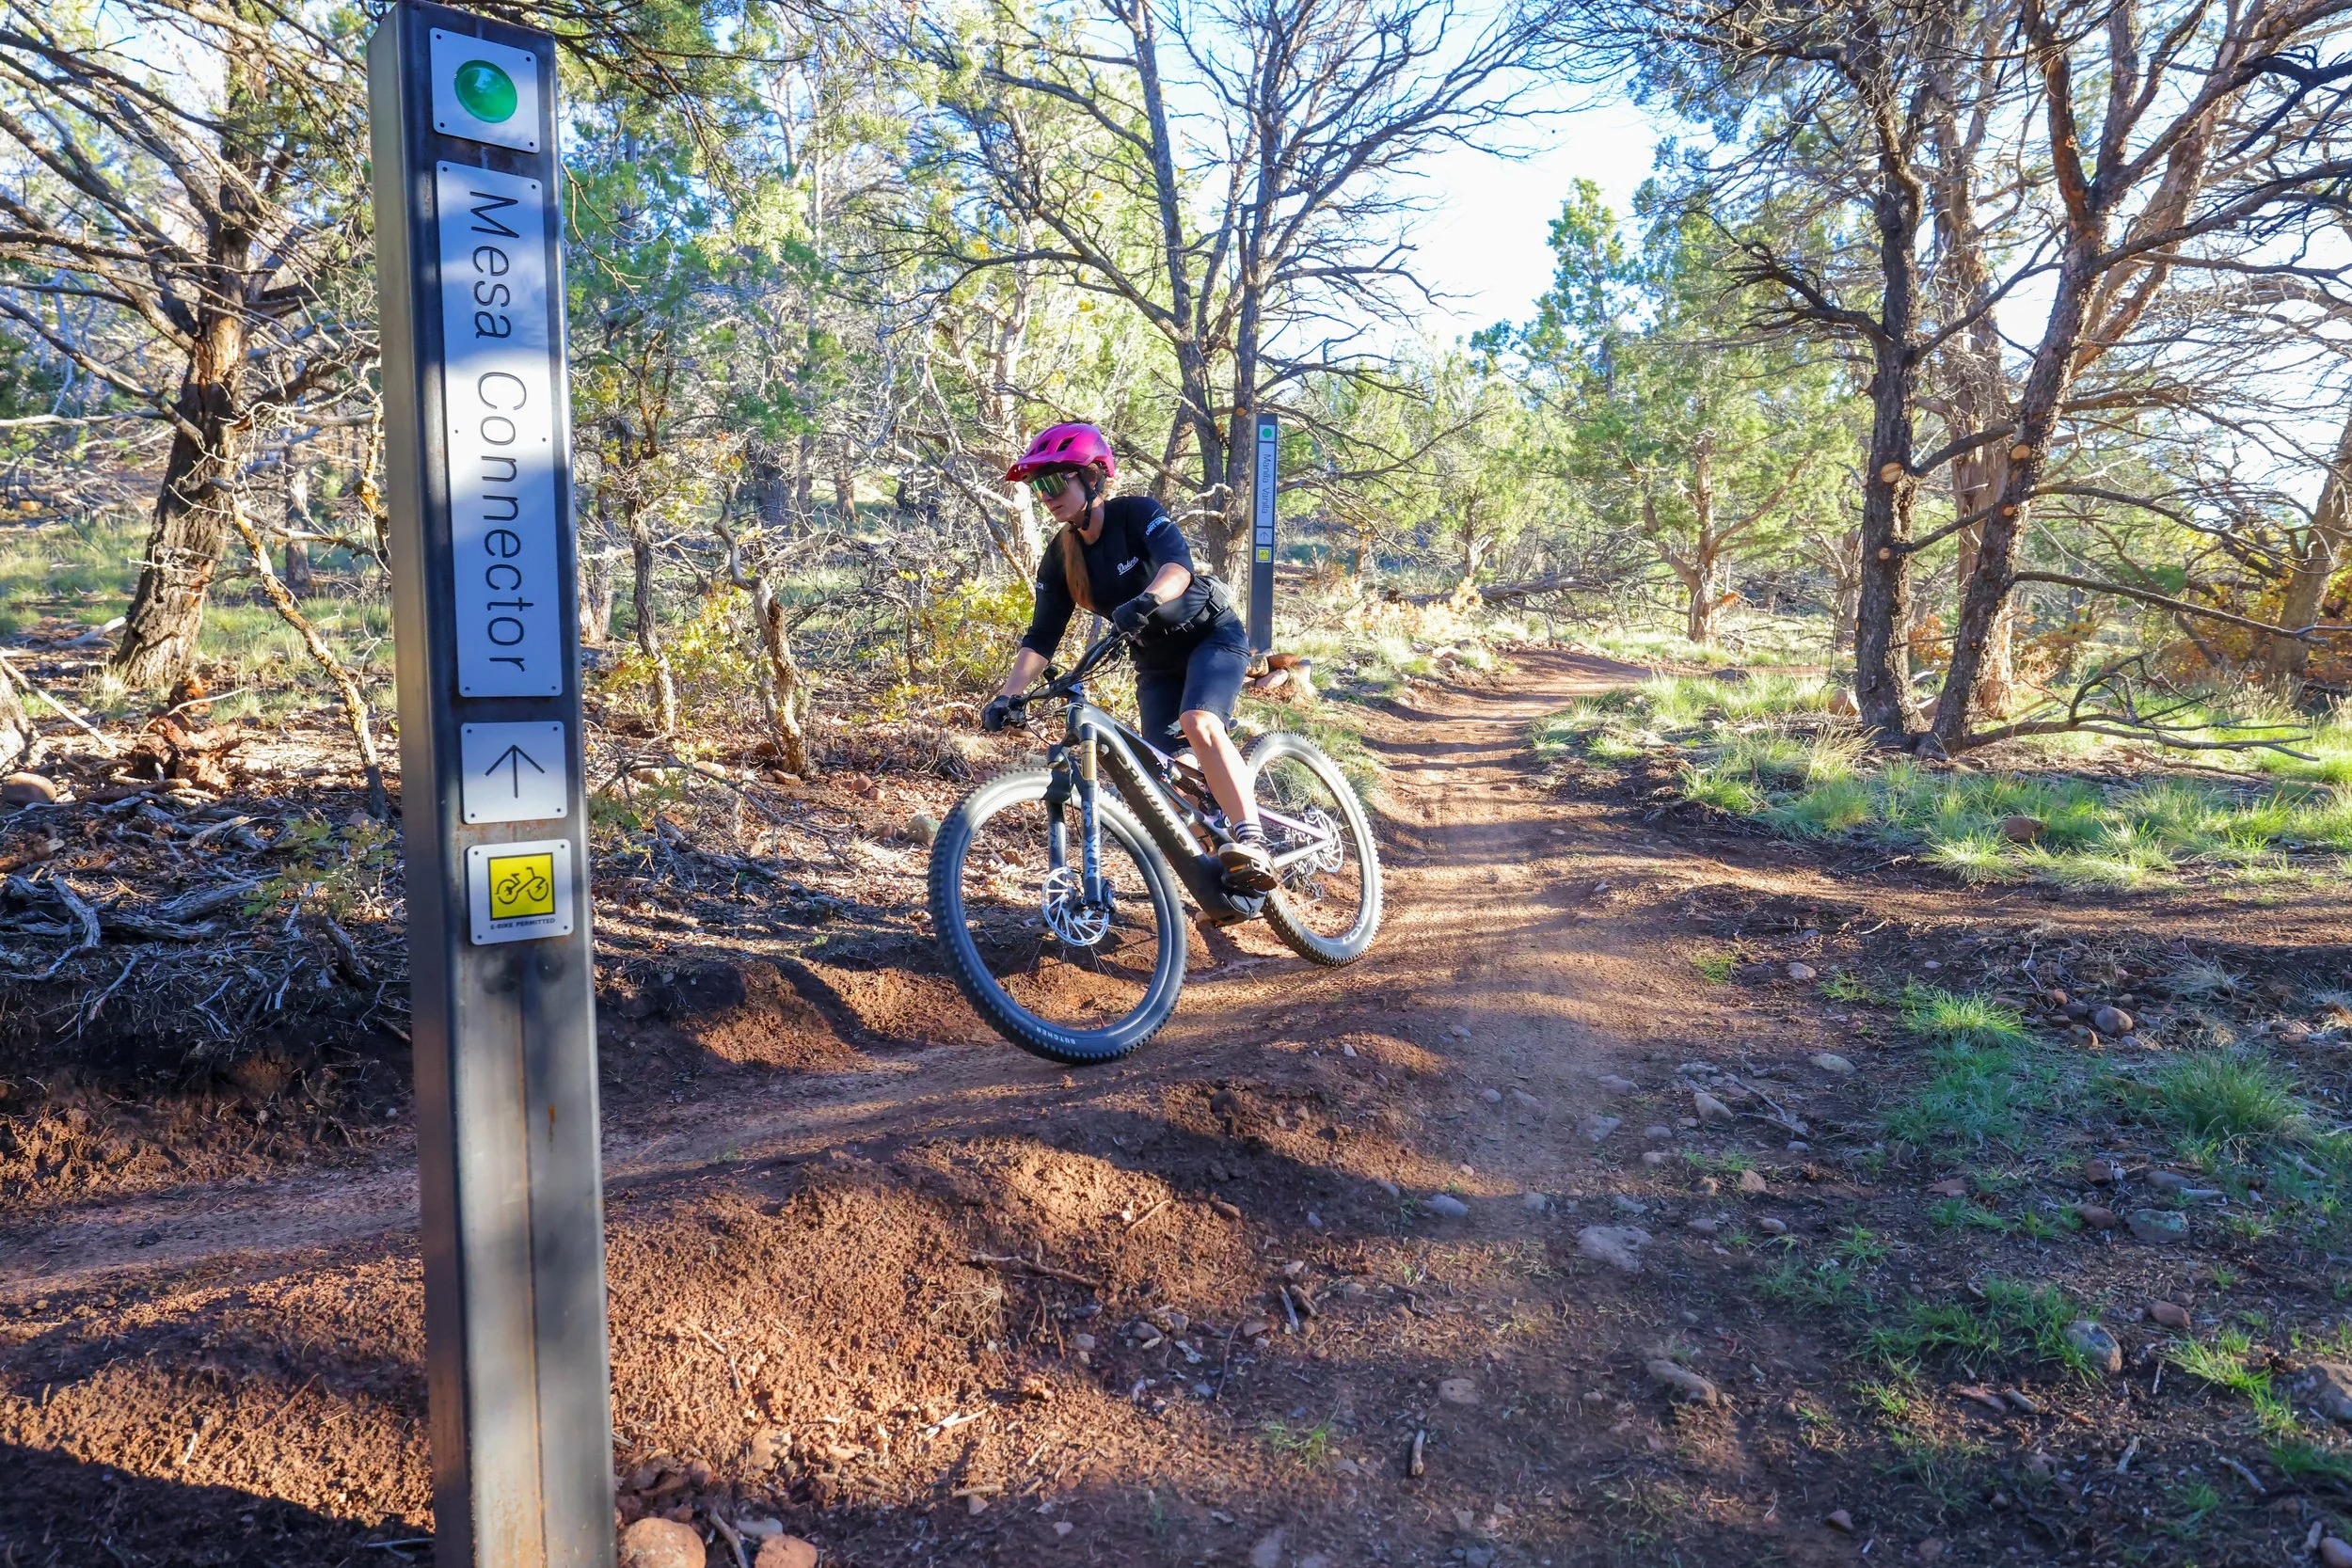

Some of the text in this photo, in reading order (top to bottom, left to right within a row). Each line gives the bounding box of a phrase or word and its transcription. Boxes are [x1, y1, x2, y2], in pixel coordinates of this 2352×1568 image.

[469, 191, 534, 673] Mesa Connector
[1261, 453, 1271, 514] Manilla Vanilla
[490, 917, 556, 930] E-BIKE PERMITTED
[1036, 1025, 1076, 1045] BUTCHER
